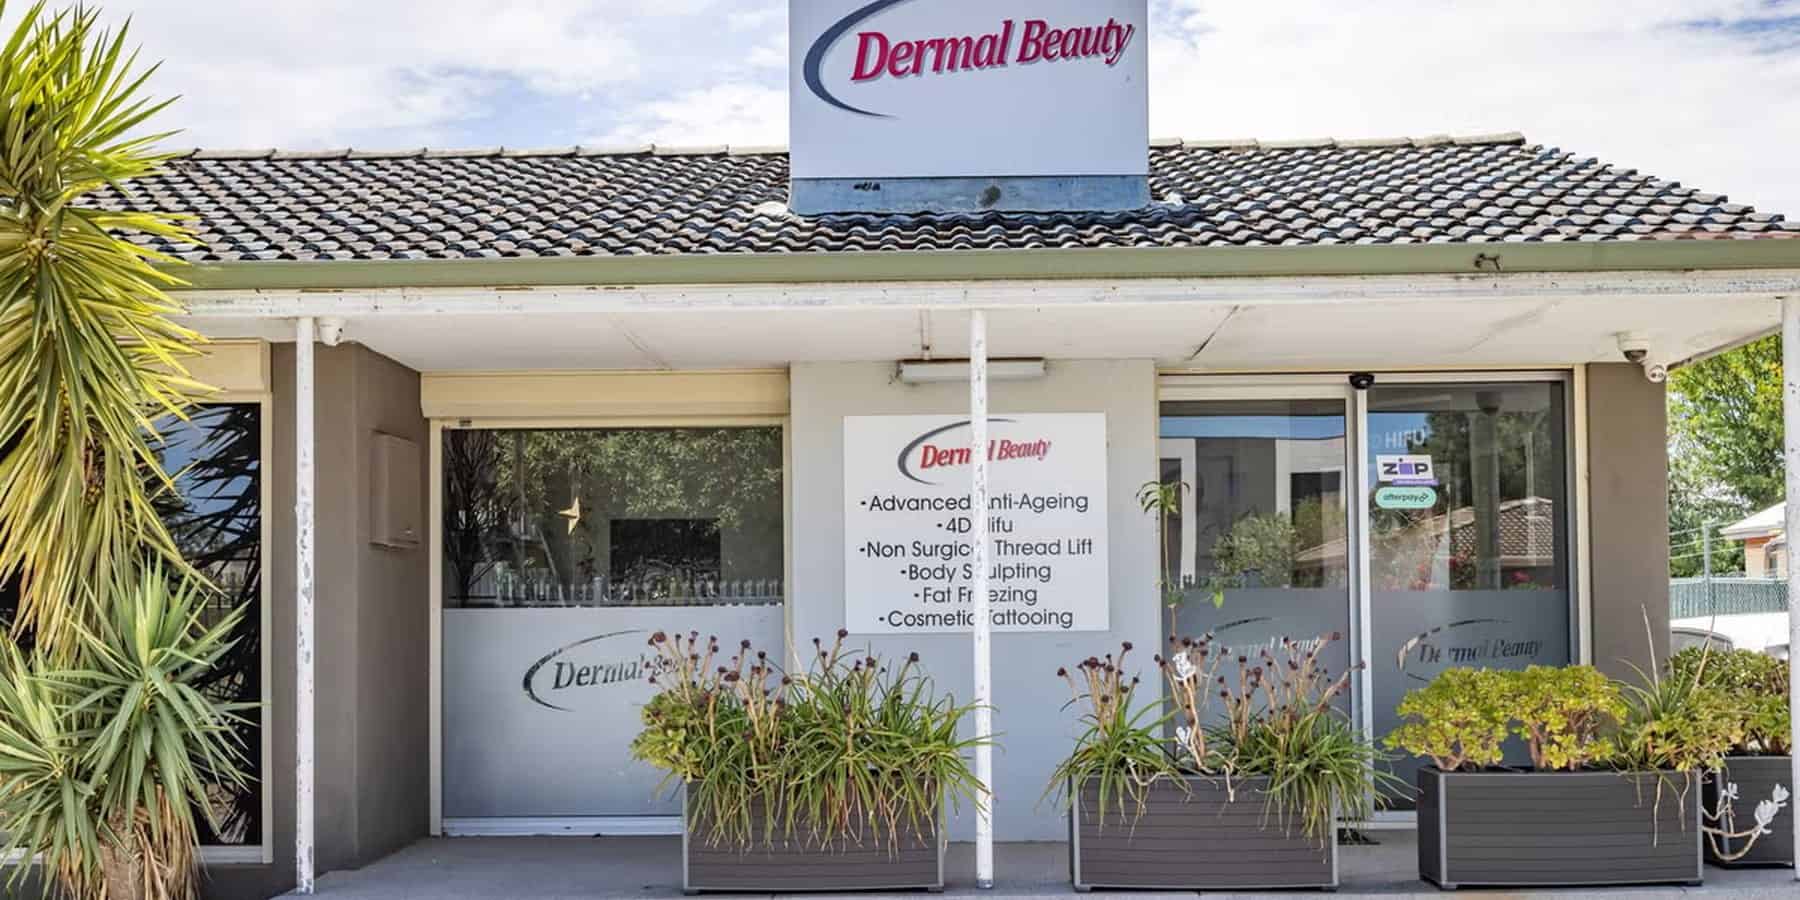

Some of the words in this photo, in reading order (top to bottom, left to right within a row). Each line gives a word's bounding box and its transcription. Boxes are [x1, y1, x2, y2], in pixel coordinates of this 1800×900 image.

[851, 20, 1013, 82] Dermal
[1016, 17, 1134, 65] Beauty
[920, 439, 995, 469] Derml
[997, 438, 1051, 461] Beauty
[869, 494, 971, 511] Advanced
[987, 492, 1089, 513] nti-Ageing
[945, 517, 972, 533] 4D
[987, 516, 1013, 533] ifu
[867, 541, 905, 558] Non
[911, 540, 976, 561] Surgic
[994, 538, 1061, 556] Thread
[1067, 538, 1093, 556] Lift
[908, 564, 957, 583] Body
[962, 562, 1052, 583] Sulpting
[923, 587, 952, 604] Fat
[958, 586, 1038, 606] Frezing
[888, 609, 975, 627] Cosmetic
[988, 608, 1074, 629] attooing
